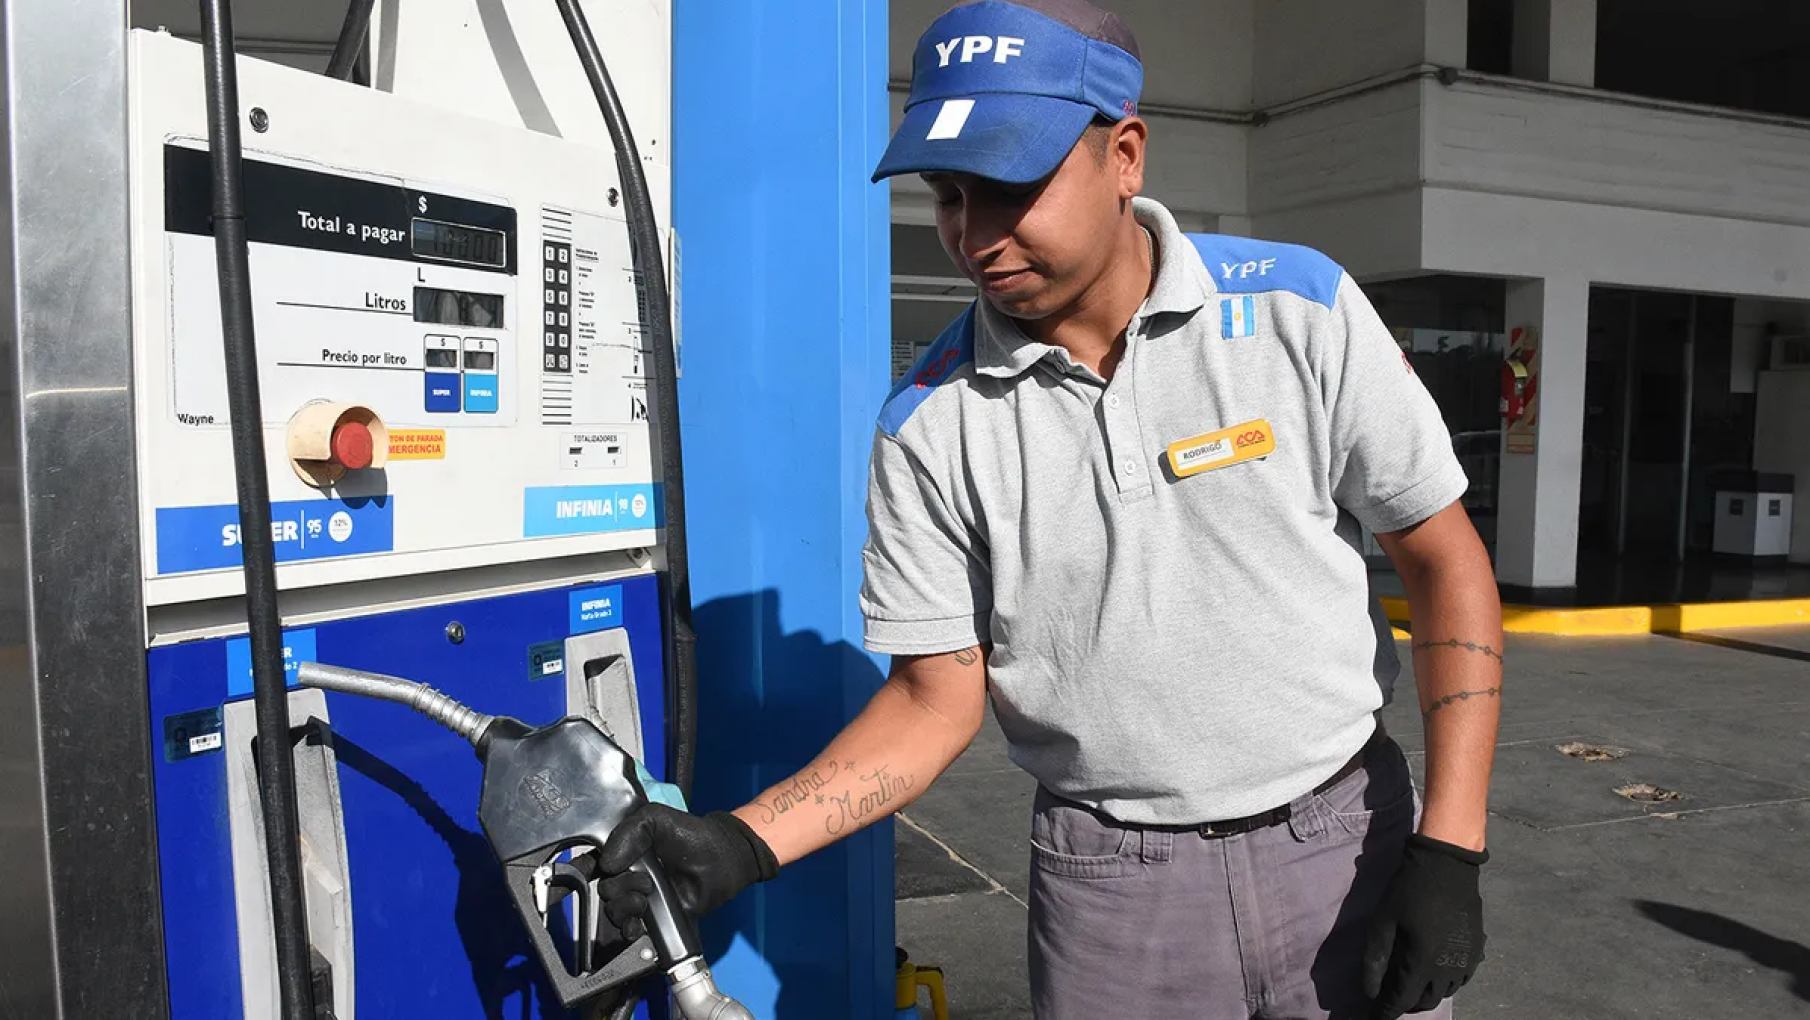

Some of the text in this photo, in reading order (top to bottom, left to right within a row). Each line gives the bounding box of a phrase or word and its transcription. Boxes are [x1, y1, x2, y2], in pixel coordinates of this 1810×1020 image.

[935, 35, 1025, 68] YPF
[418, 195, 428, 214] $
[297, 210, 406, 244] Total a pagar
[417, 267, 426, 283] L
[1220, 257, 1277, 279] YPF
[365, 292, 407, 311] Litros
[321, 349, 407, 367] Precio por litro
[178, 413, 214, 426] Wayne
[389, 434, 404, 443] TON
[417, 434, 443, 442] PARADA
[574, 434, 618, 443] TOTALIZADORES
[388, 444, 441, 454] MERGENCIA
[556, 499, 613, 518] INFINIA
[222, 520, 298, 546] SER
[307, 519, 322, 534] 95
[752, 760, 838, 825] Sandra
